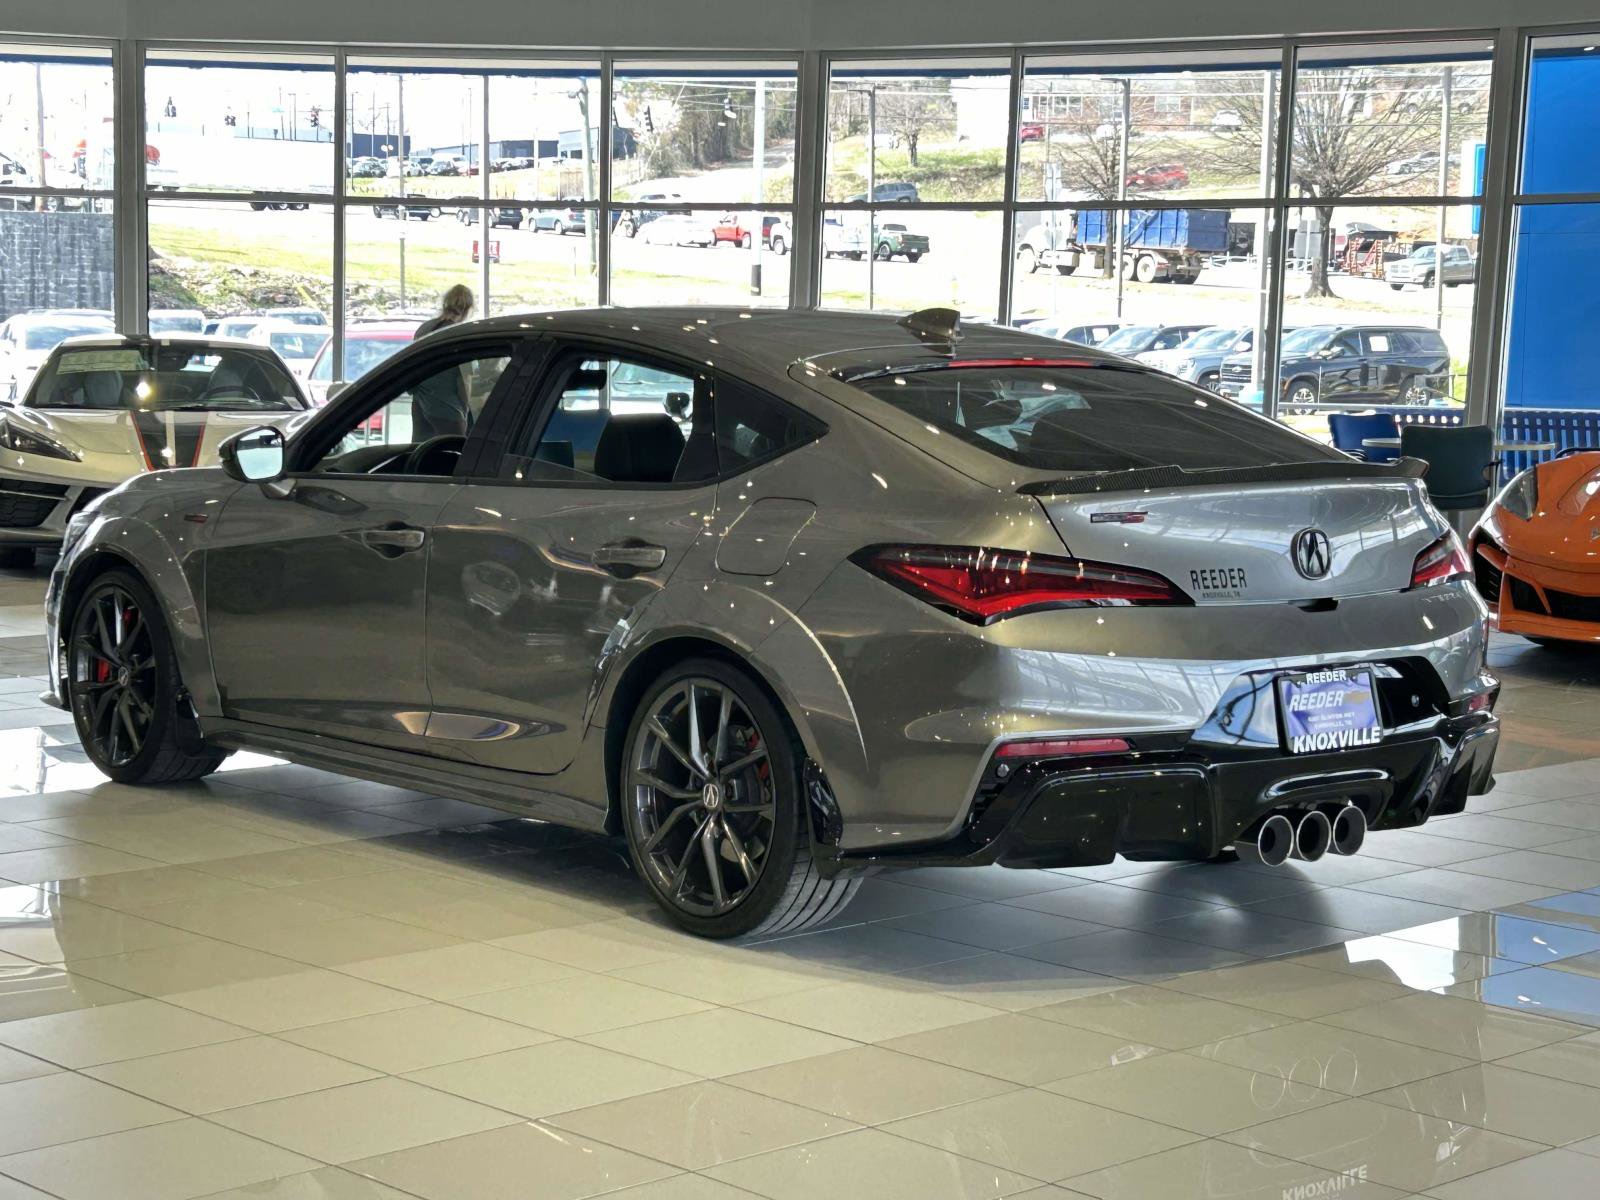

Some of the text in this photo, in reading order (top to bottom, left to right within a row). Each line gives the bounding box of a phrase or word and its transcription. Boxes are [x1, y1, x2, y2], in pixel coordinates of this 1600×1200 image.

[1190, 567, 1247, 590] REEDER
[1305, 669, 1347, 685] REEDER
[1289, 690, 1345, 712] REEDER
[1293, 726, 1381, 754] KNOXVILLE
